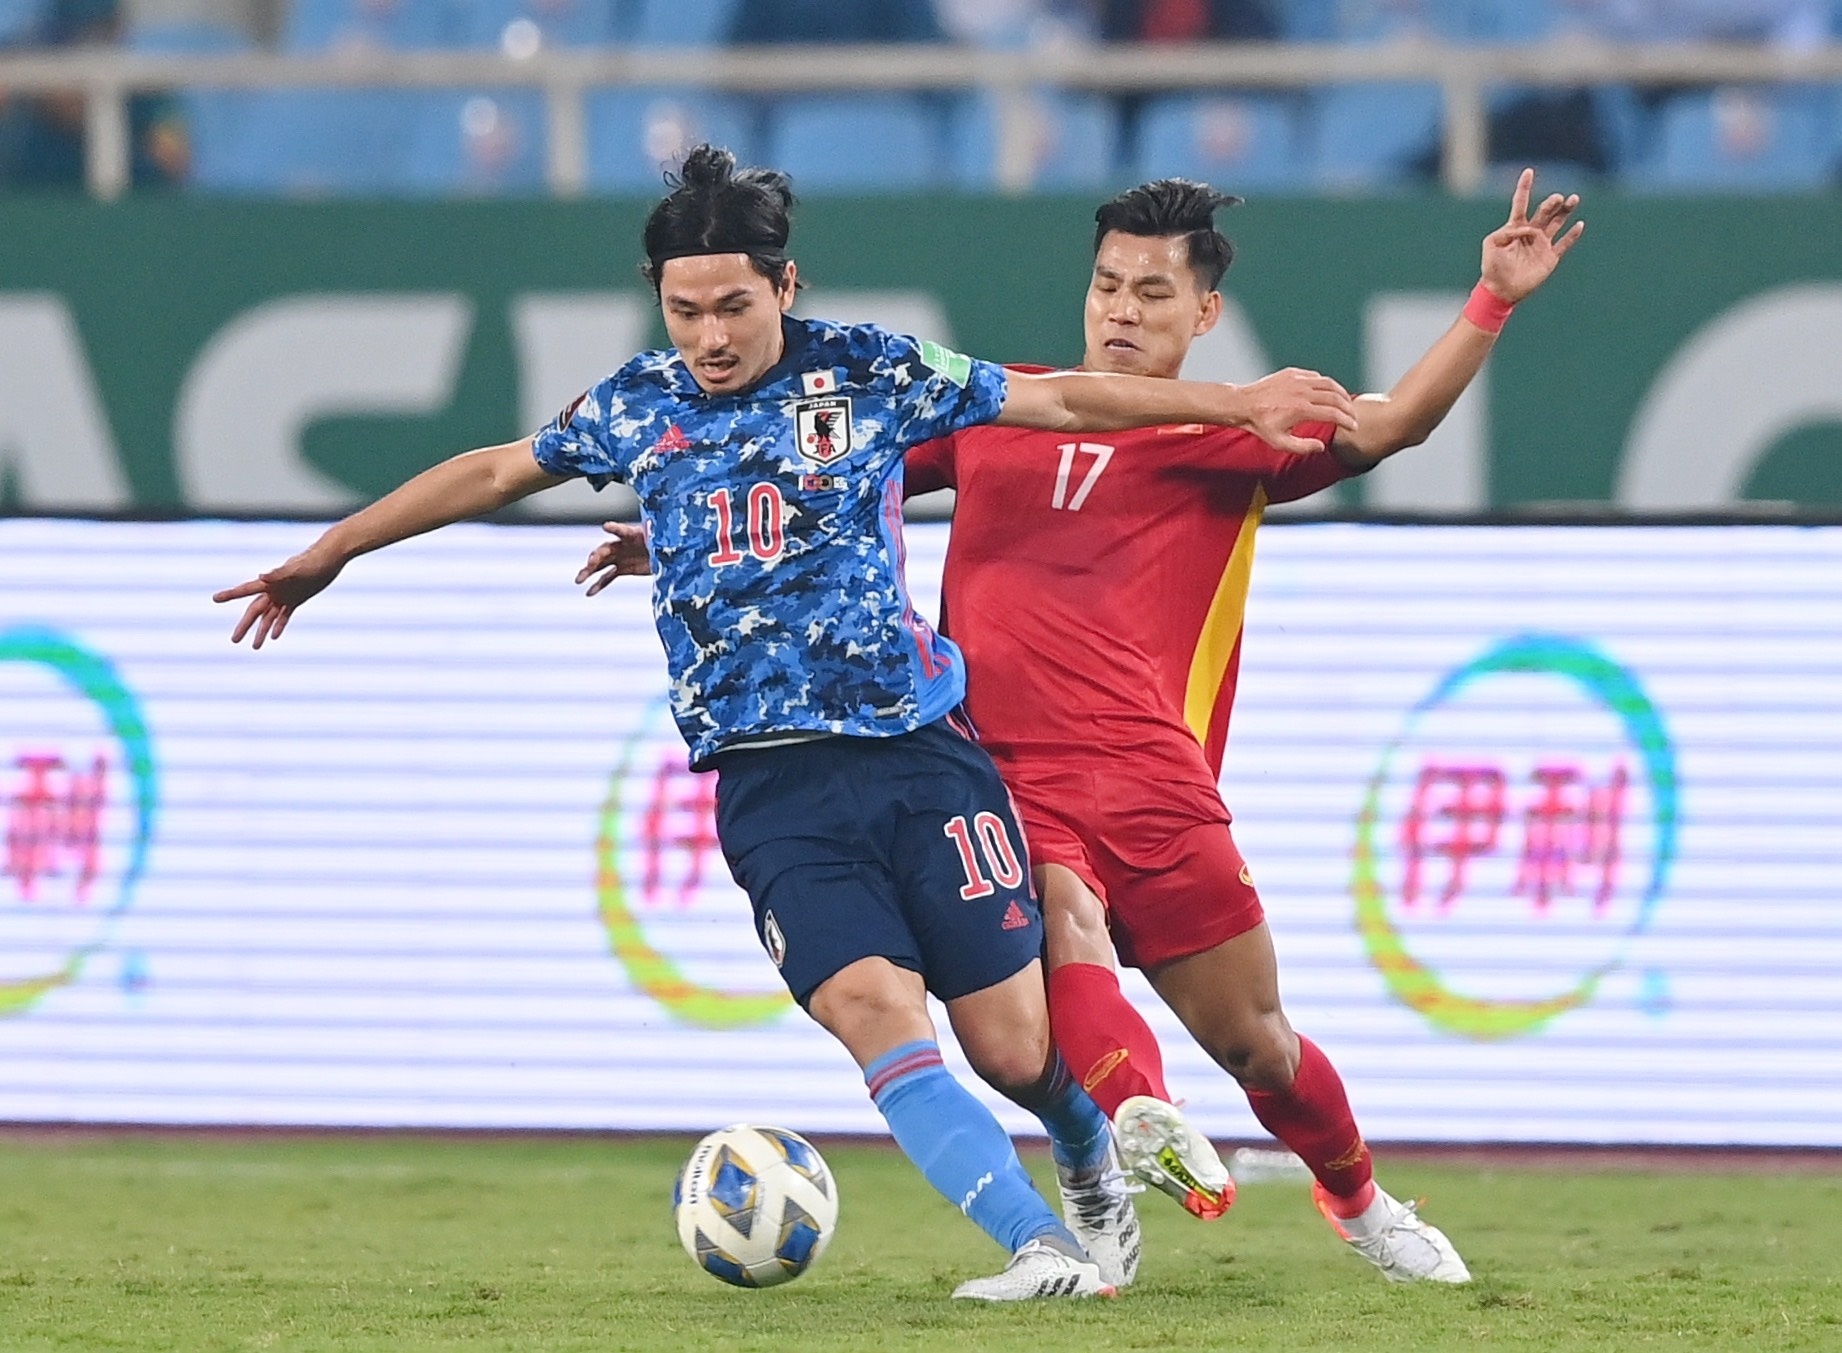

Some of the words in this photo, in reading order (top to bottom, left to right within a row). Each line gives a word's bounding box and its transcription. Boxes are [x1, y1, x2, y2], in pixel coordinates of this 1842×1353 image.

[808, 401, 836, 409] JAPAN
[813, 445, 836, 454] JFA
[1052, 443, 1115, 511] 17
[707, 481, 784, 567] 10
[943, 811, 1022, 900] 10
[1402, 762, 1629, 912] 伊利
